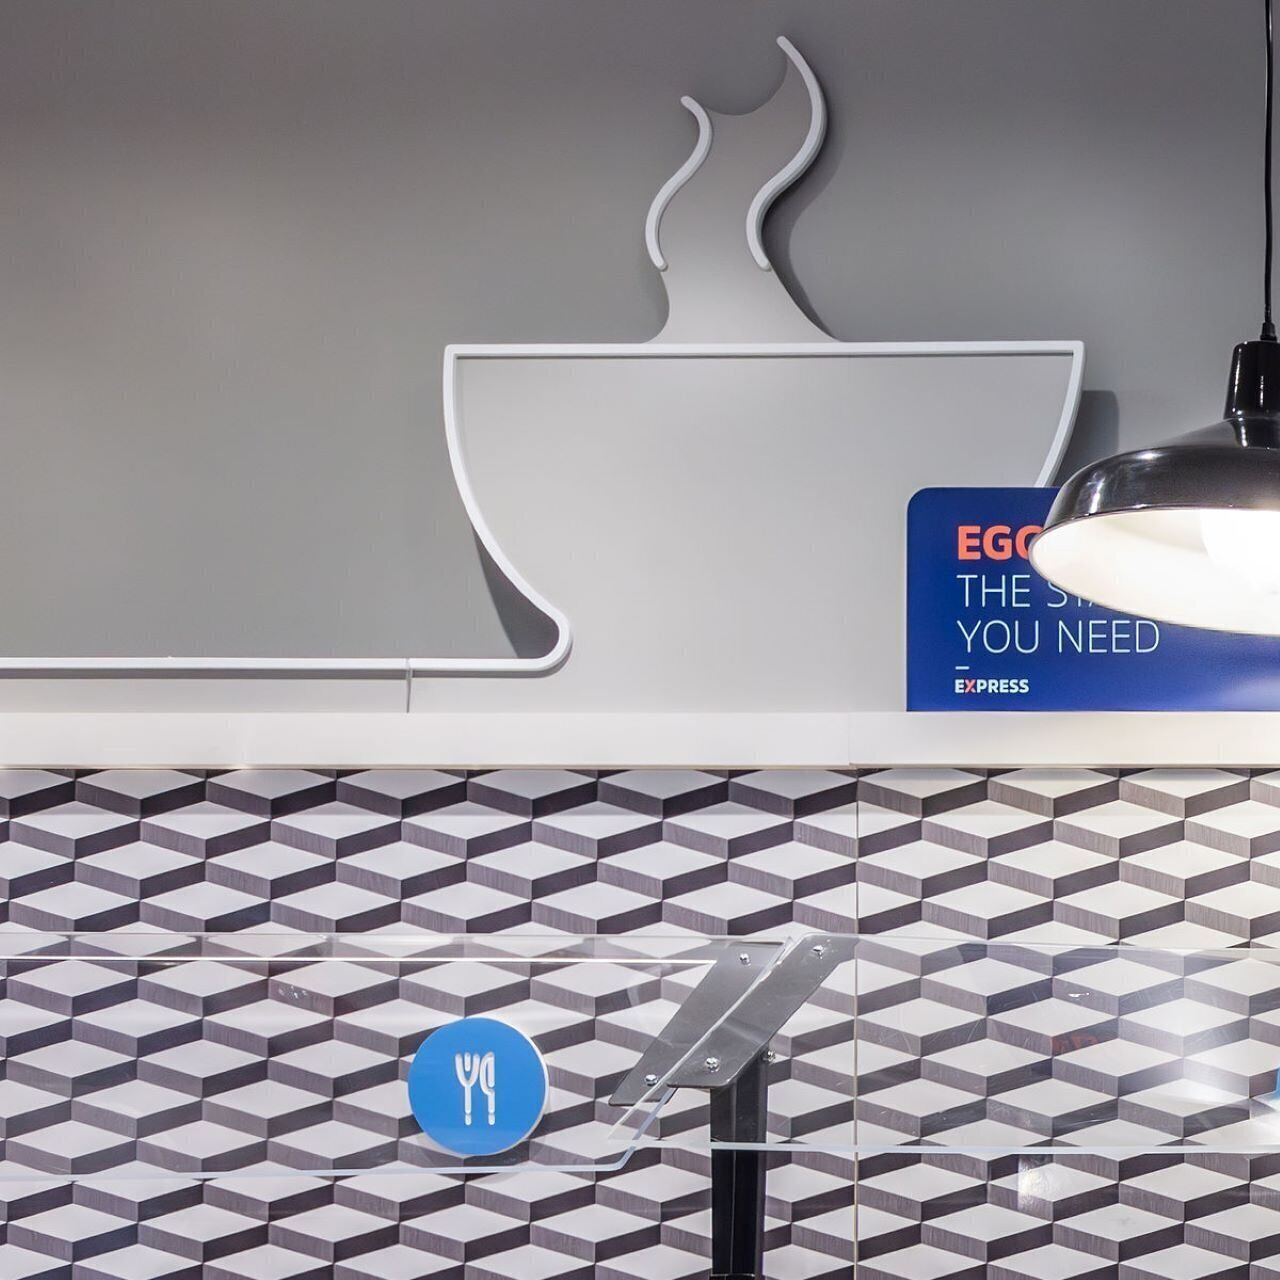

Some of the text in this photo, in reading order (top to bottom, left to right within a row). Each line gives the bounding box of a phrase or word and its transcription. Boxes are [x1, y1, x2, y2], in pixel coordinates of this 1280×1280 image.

[956, 573, 1031, 607] THE
[956, 619, 1161, 654] YOU NEED
[954, 678, 1030, 694] EXPRESS
